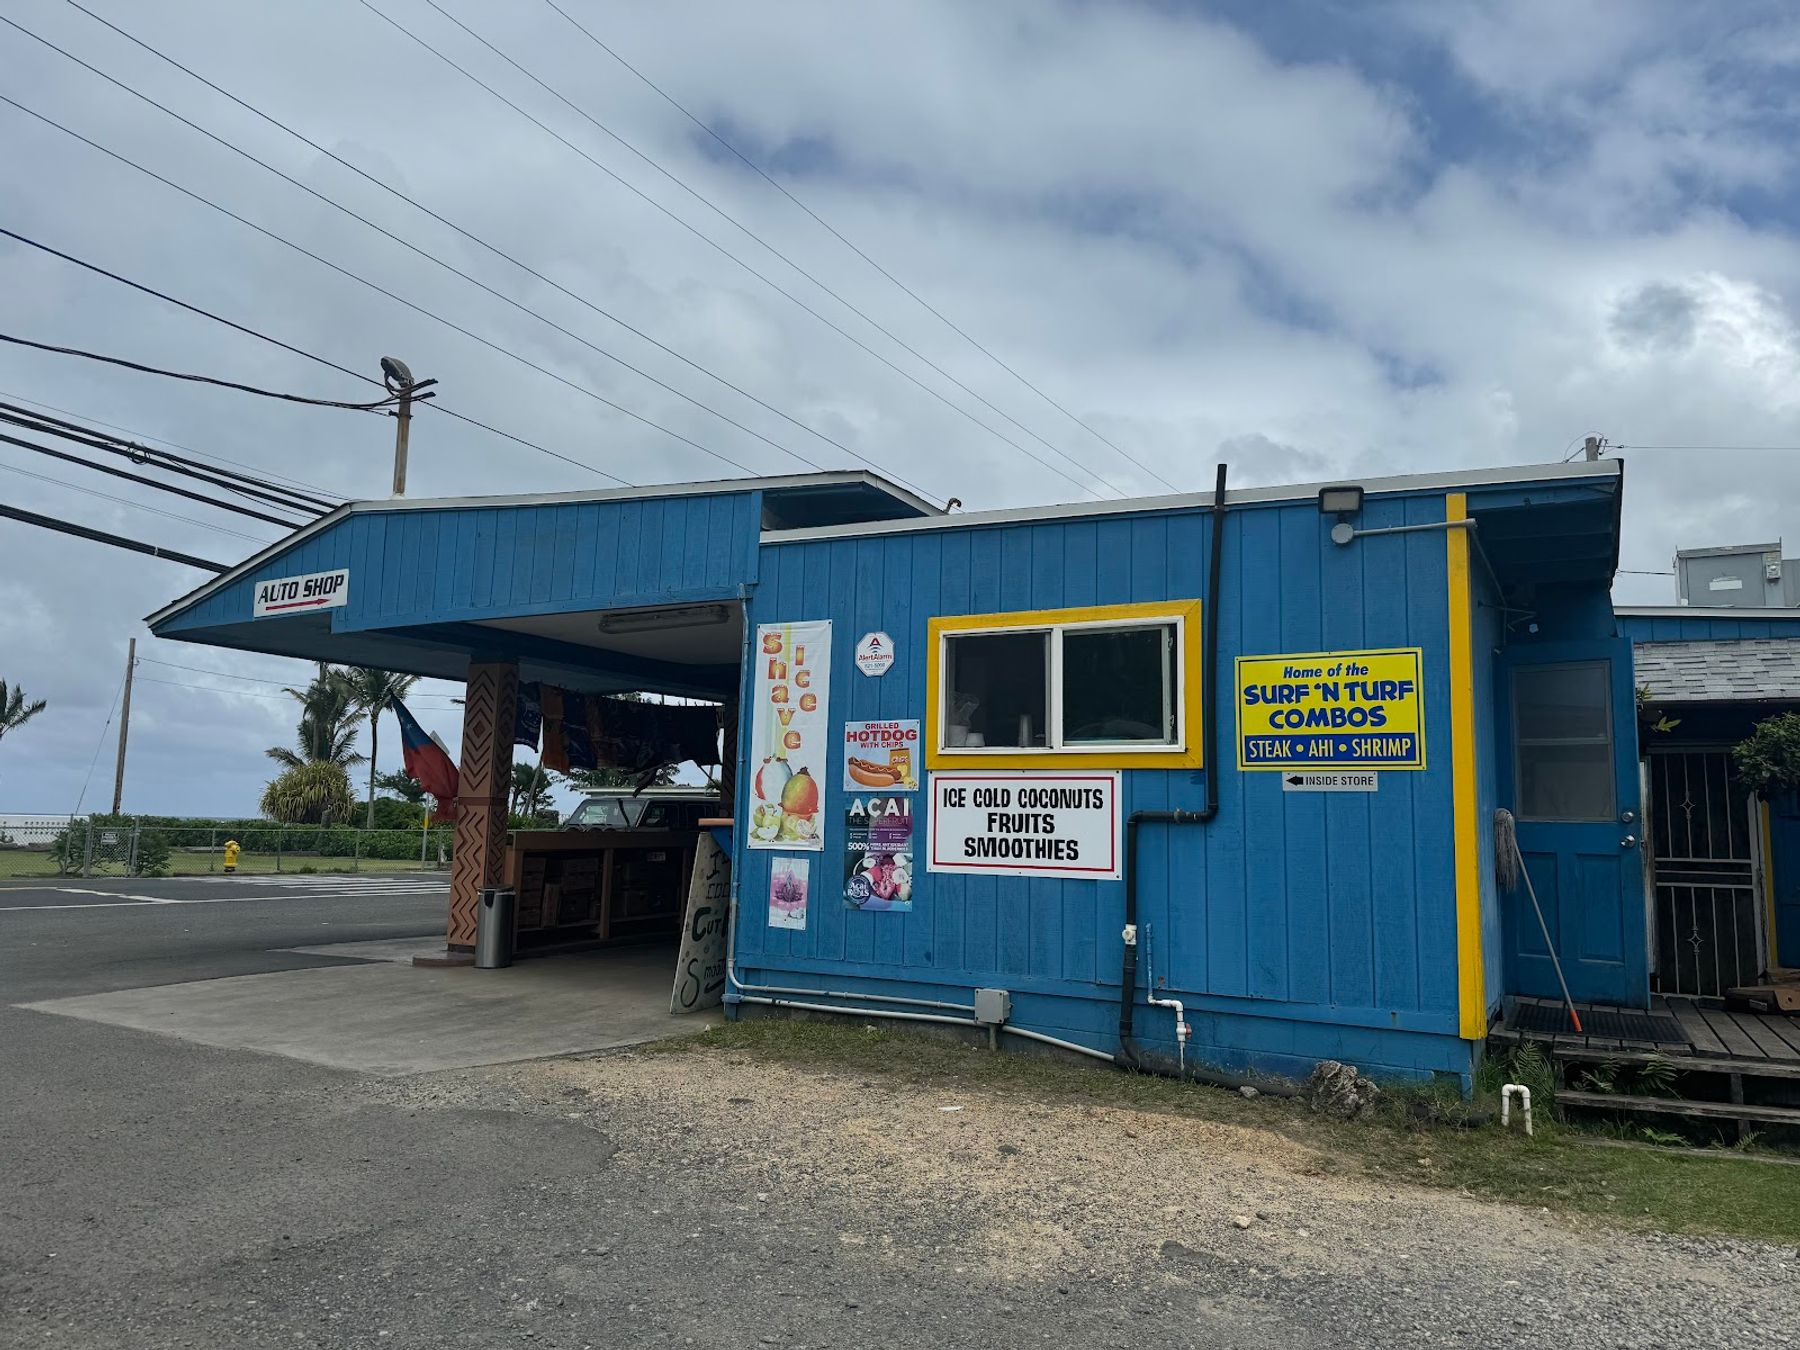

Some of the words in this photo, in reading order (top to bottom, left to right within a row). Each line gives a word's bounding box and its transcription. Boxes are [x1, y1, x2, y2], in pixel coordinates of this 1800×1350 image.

[258, 581, 299, 604] AUTO
[303, 574, 345, 598] SHOP
[858, 653, 893, 661] AlertAlarm
[1283, 666, 1322, 679] Home
[1327, 663, 1343, 677] of
[1345, 662, 1369, 676] the
[1243, 684, 1310, 705] SURF
[1344, 680, 1414, 701] TURF
[865, 722, 899, 730] GRILLED
[1269, 705, 1387, 729] COMBOS
[846, 729, 917, 742] HOTDOG
[1249, 739, 1292, 758] STEAK
[1308, 739, 1334, 757] AHI
[1352, 738, 1411, 757] SHRIMP
[1305, 776, 1338, 786] INSIDE
[1341, 776, 1374, 786] STORE
[943, 788, 966, 808] ICE
[973, 788, 1011, 808] COLD
[1018, 788, 1104, 809] COCONUTS
[987, 813, 1056, 834] FRUITS
[848, 842, 870, 851] 500%
[964, 837, 1079, 860] SMOOTHIES
